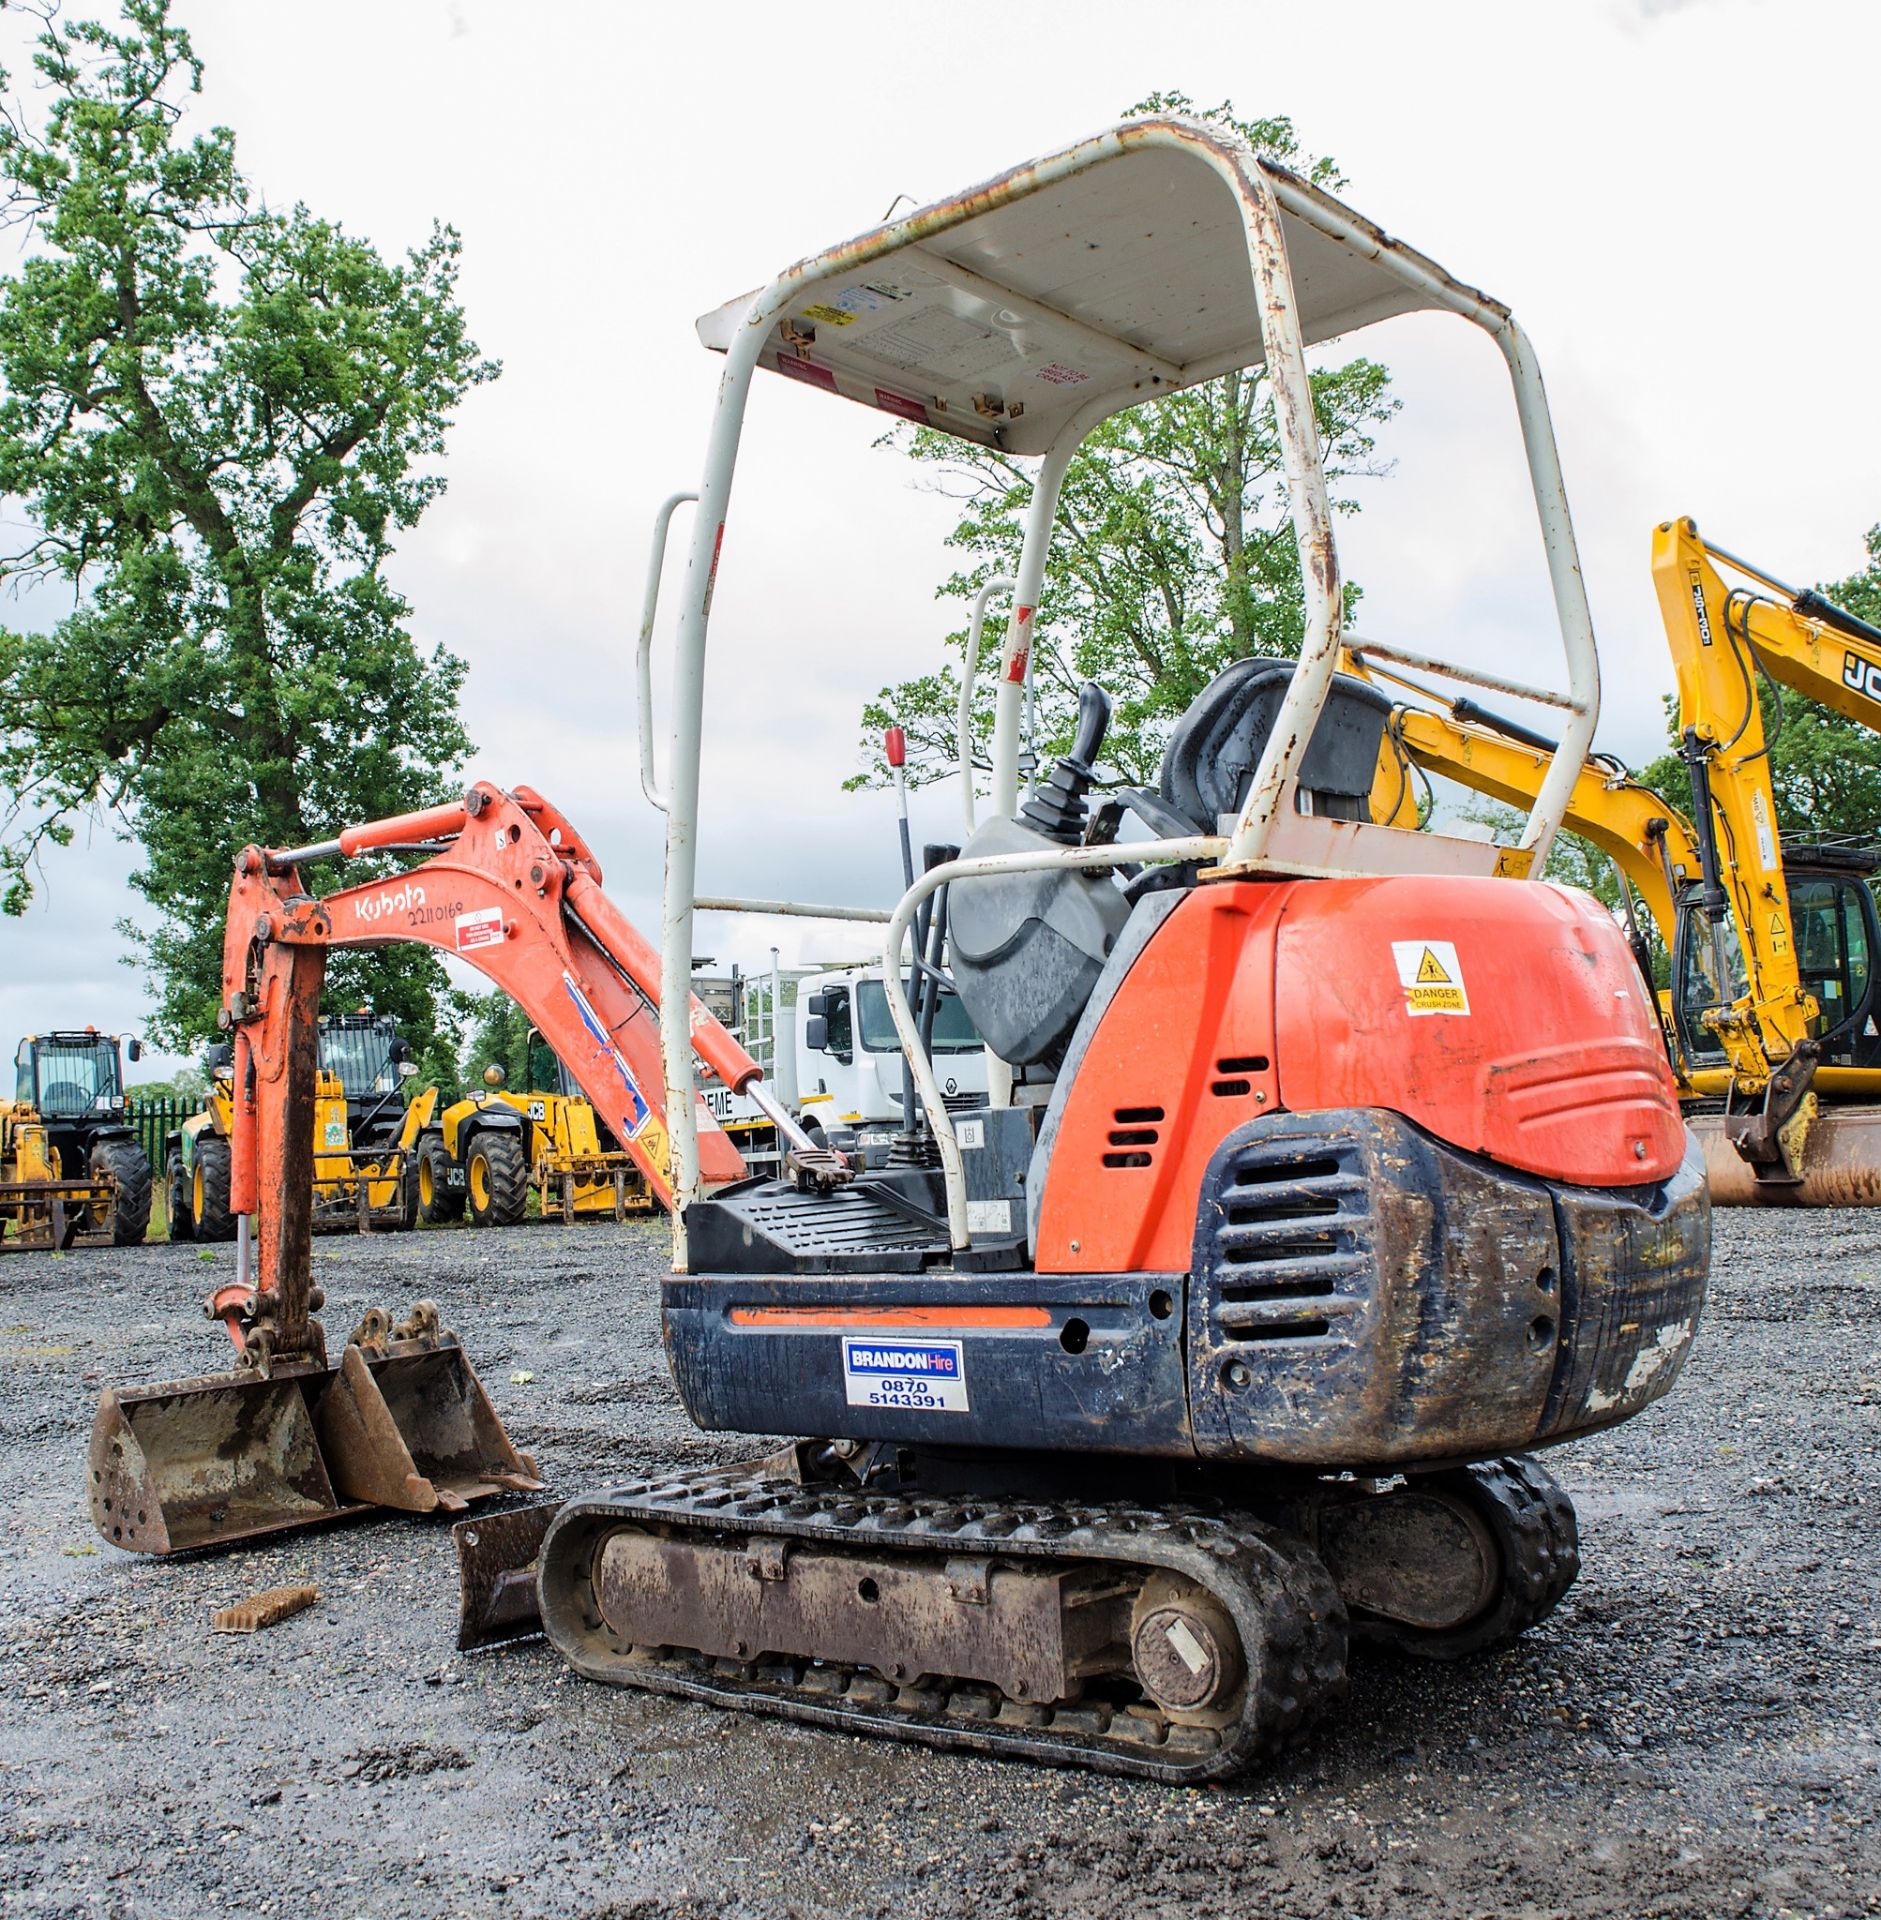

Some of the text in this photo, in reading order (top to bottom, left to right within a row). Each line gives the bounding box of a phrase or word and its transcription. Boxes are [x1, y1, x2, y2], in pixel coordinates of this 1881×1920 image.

[354, 883, 426, 922] Kubota
[1414, 989, 1458, 998] DANGER
[1416, 1001, 1461, 1009] CRUSH ZONE
[527, 1101, 545, 1120] JCB
[701, 1091, 733, 1115] EME
[447, 1167, 466, 1187] JCB
[881, 1380, 928, 1394] 0870
[869, 1393, 945, 1408] 5143391
